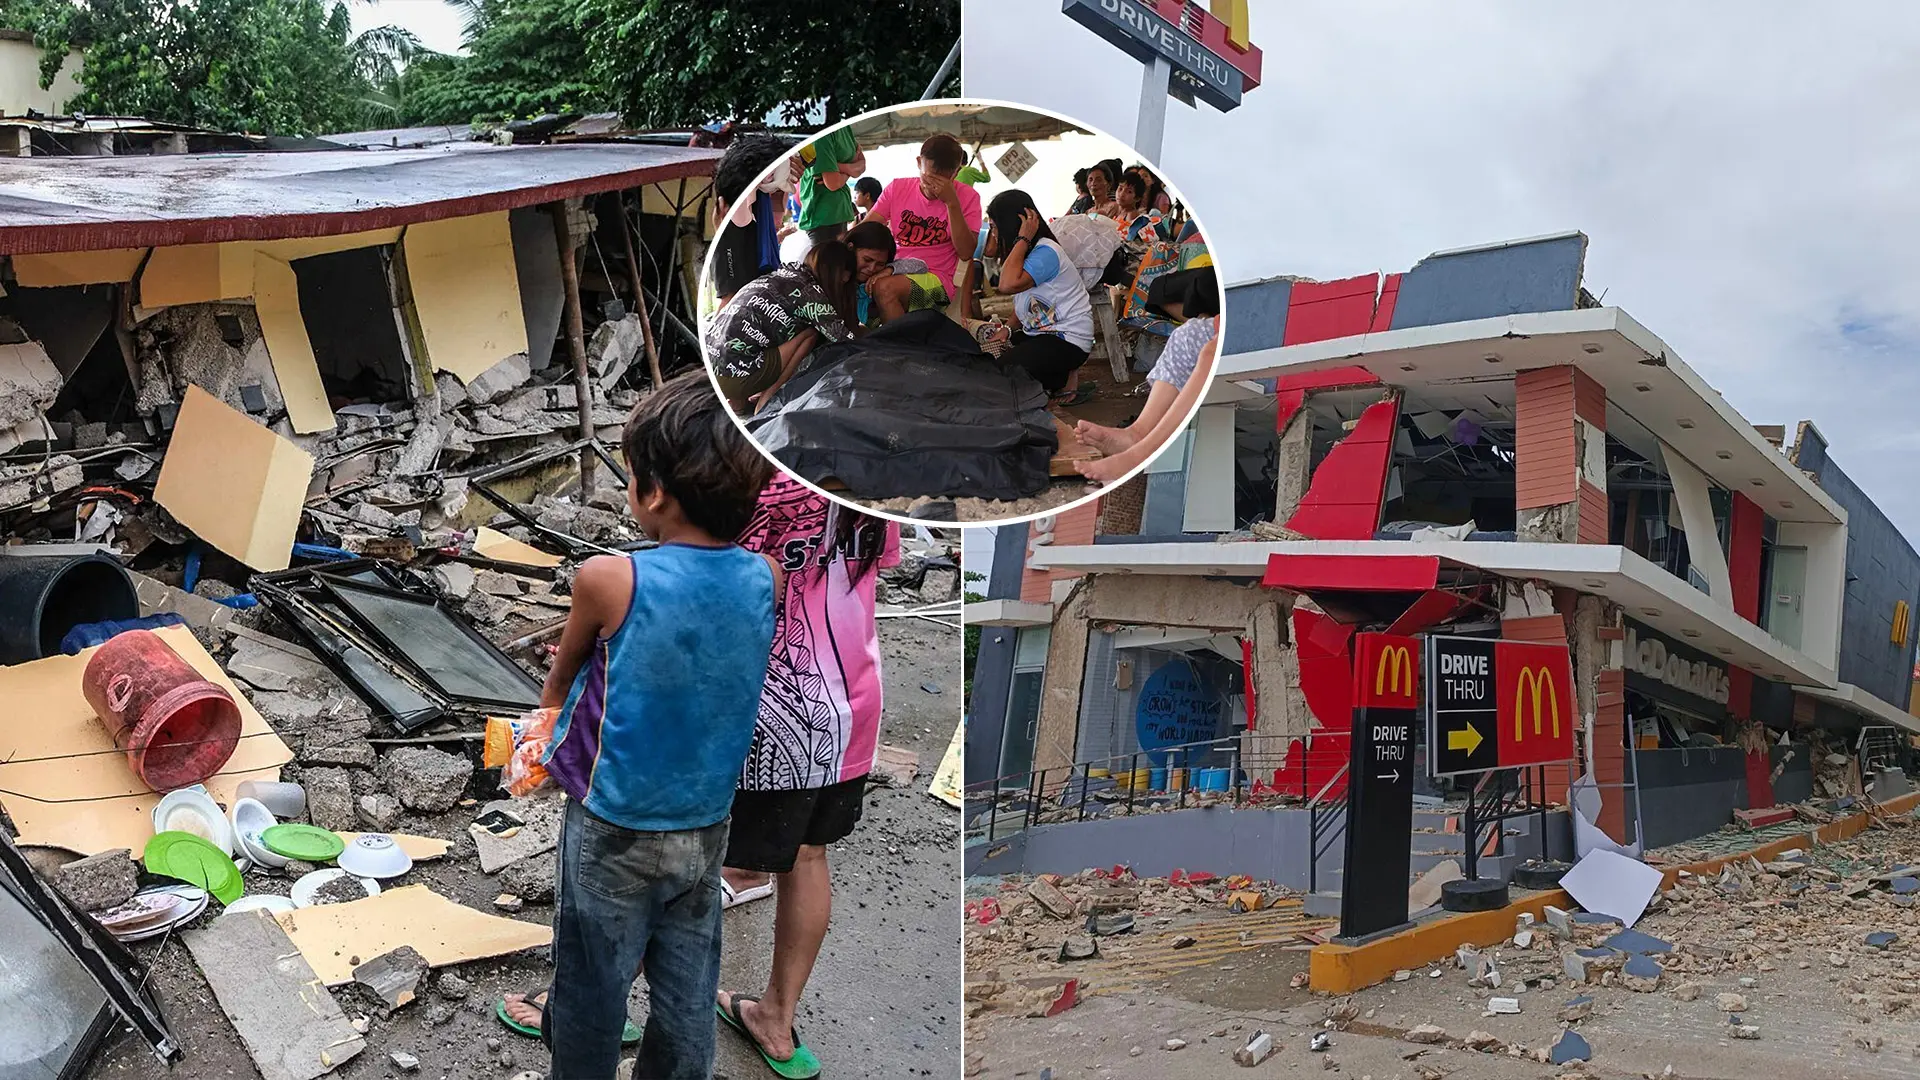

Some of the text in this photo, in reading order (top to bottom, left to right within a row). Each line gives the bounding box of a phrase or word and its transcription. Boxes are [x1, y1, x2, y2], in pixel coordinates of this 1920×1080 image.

[1001, 150, 1018, 167] OPD
[1440, 653, 1488, 676] DRIVE
[1444, 679, 1485, 700] THRU
[1158, 726, 1186, 741] WORLD
[1372, 726, 1408, 741] DRIVE
[1375, 745, 1405, 761] THRU
